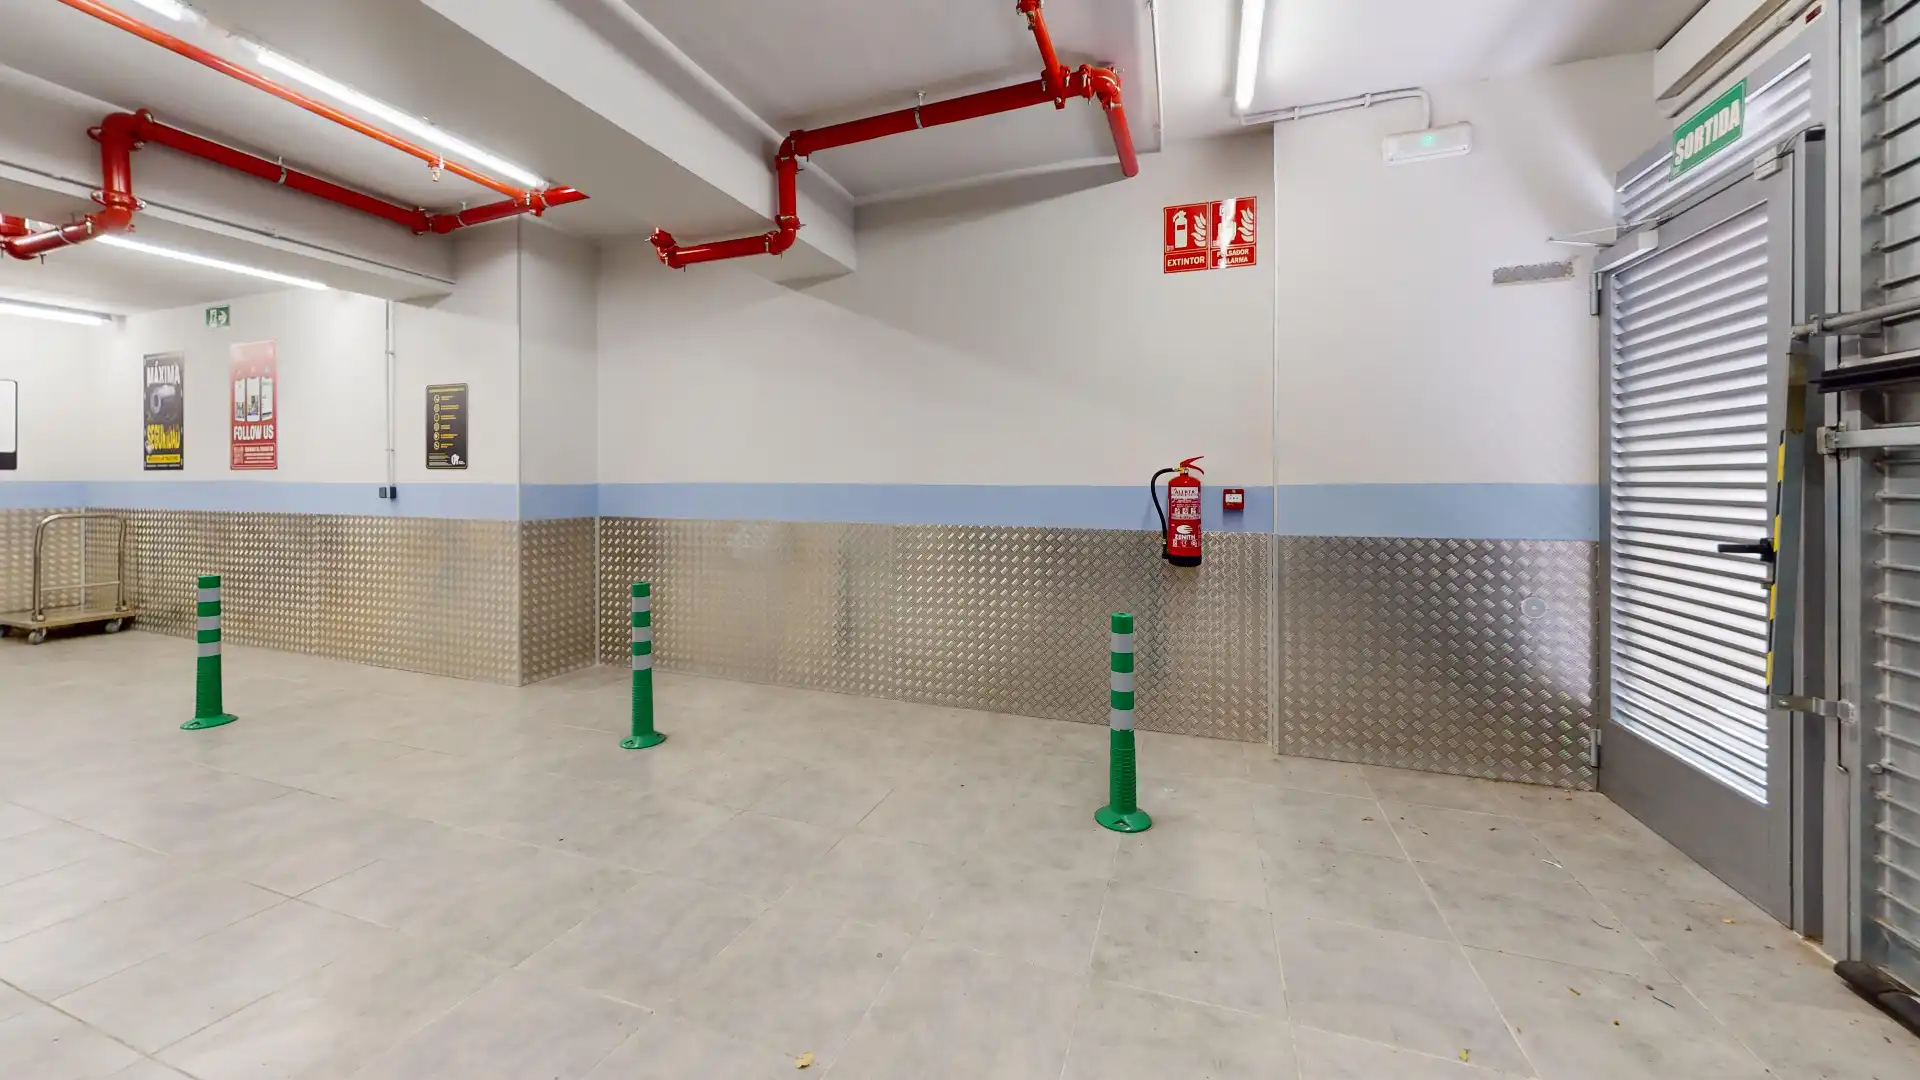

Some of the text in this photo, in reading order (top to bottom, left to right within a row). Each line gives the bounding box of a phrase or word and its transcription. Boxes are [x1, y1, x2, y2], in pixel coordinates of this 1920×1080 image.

[1675, 99, 1740, 165] SORTIDA
[1167, 256, 1205, 267] EXTINTOR
[146, 360, 180, 387] MÁXIMA
[233, 424, 274, 441] FOLLOW US
